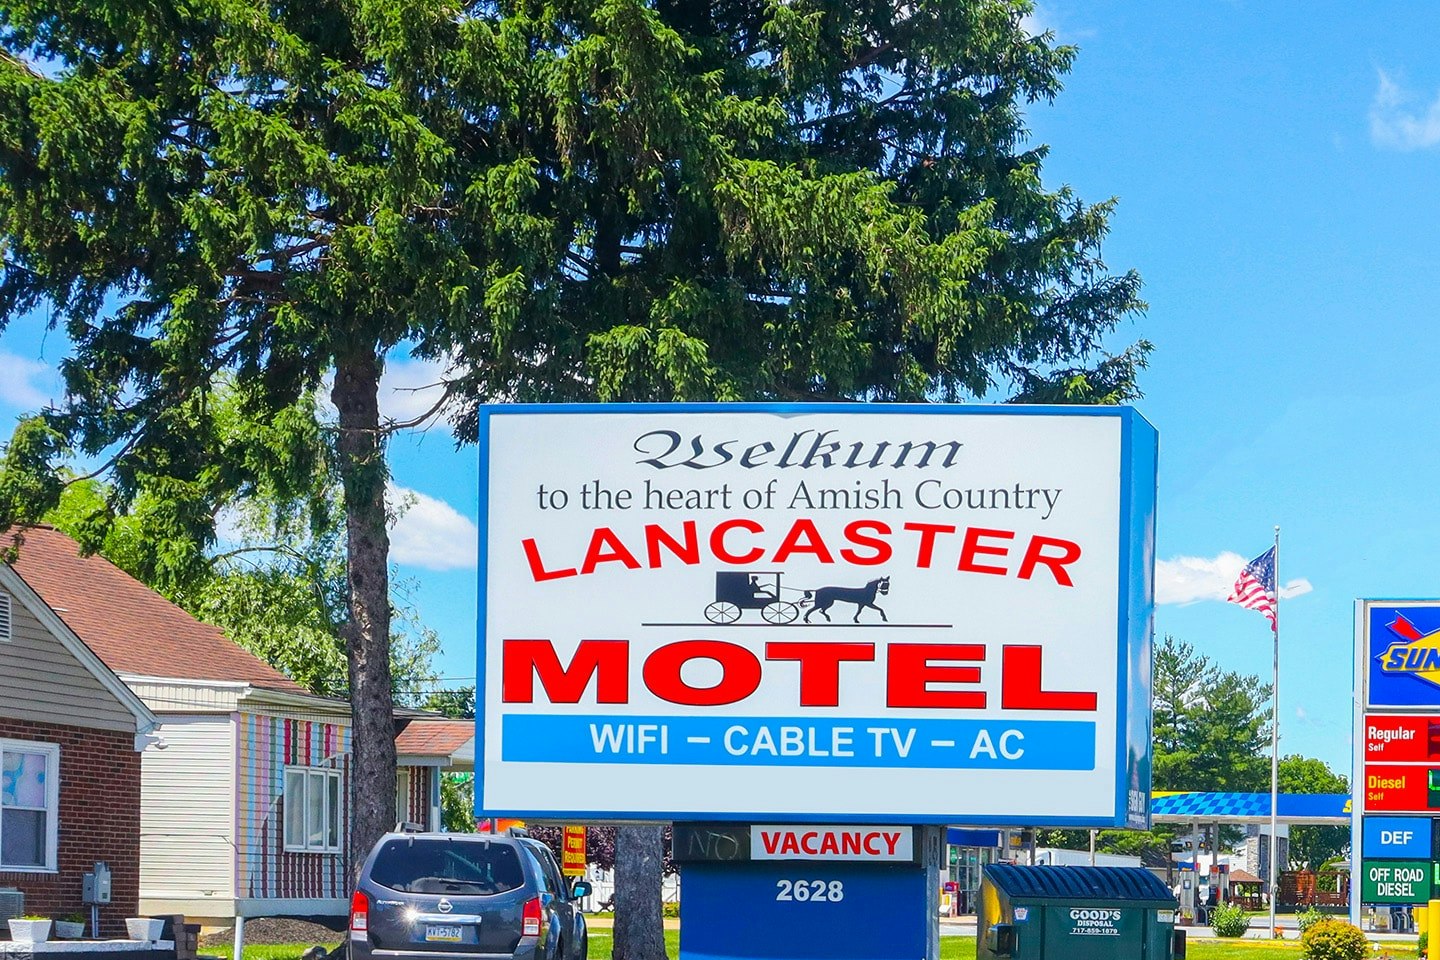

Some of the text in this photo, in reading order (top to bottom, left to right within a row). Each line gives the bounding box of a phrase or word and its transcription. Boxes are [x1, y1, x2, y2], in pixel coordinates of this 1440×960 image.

[633, 429, 964, 471] Welkum
[537, 479, 1063, 520] to the heart of Amish Country
[521, 518, 1082, 587] LANCASTER
[502, 639, 1098, 711] MOTEL
[590, 724, 669, 755] WIFI
[723, 726, 854, 758] CABLE
[867, 727, 916, 757] TV
[969, 729, 1026, 760] AC
[1368, 727, 1416, 743] Regular
[1368, 742, 1385, 752] Self
[1368, 776, 1406, 789] Diesel
[1368, 791, 1384, 801] Self
[760, 831, 902, 856] VACANCY
[1381, 831, 1413, 845] DEF
[1369, 868, 1391, 882] OFF
[1394, 868, 1424, 882] ROAD
[776, 879, 844, 902] 2628
[1377, 881, 1415, 897] DIESEL
[1069, 909, 1121, 921] GOOD'S
